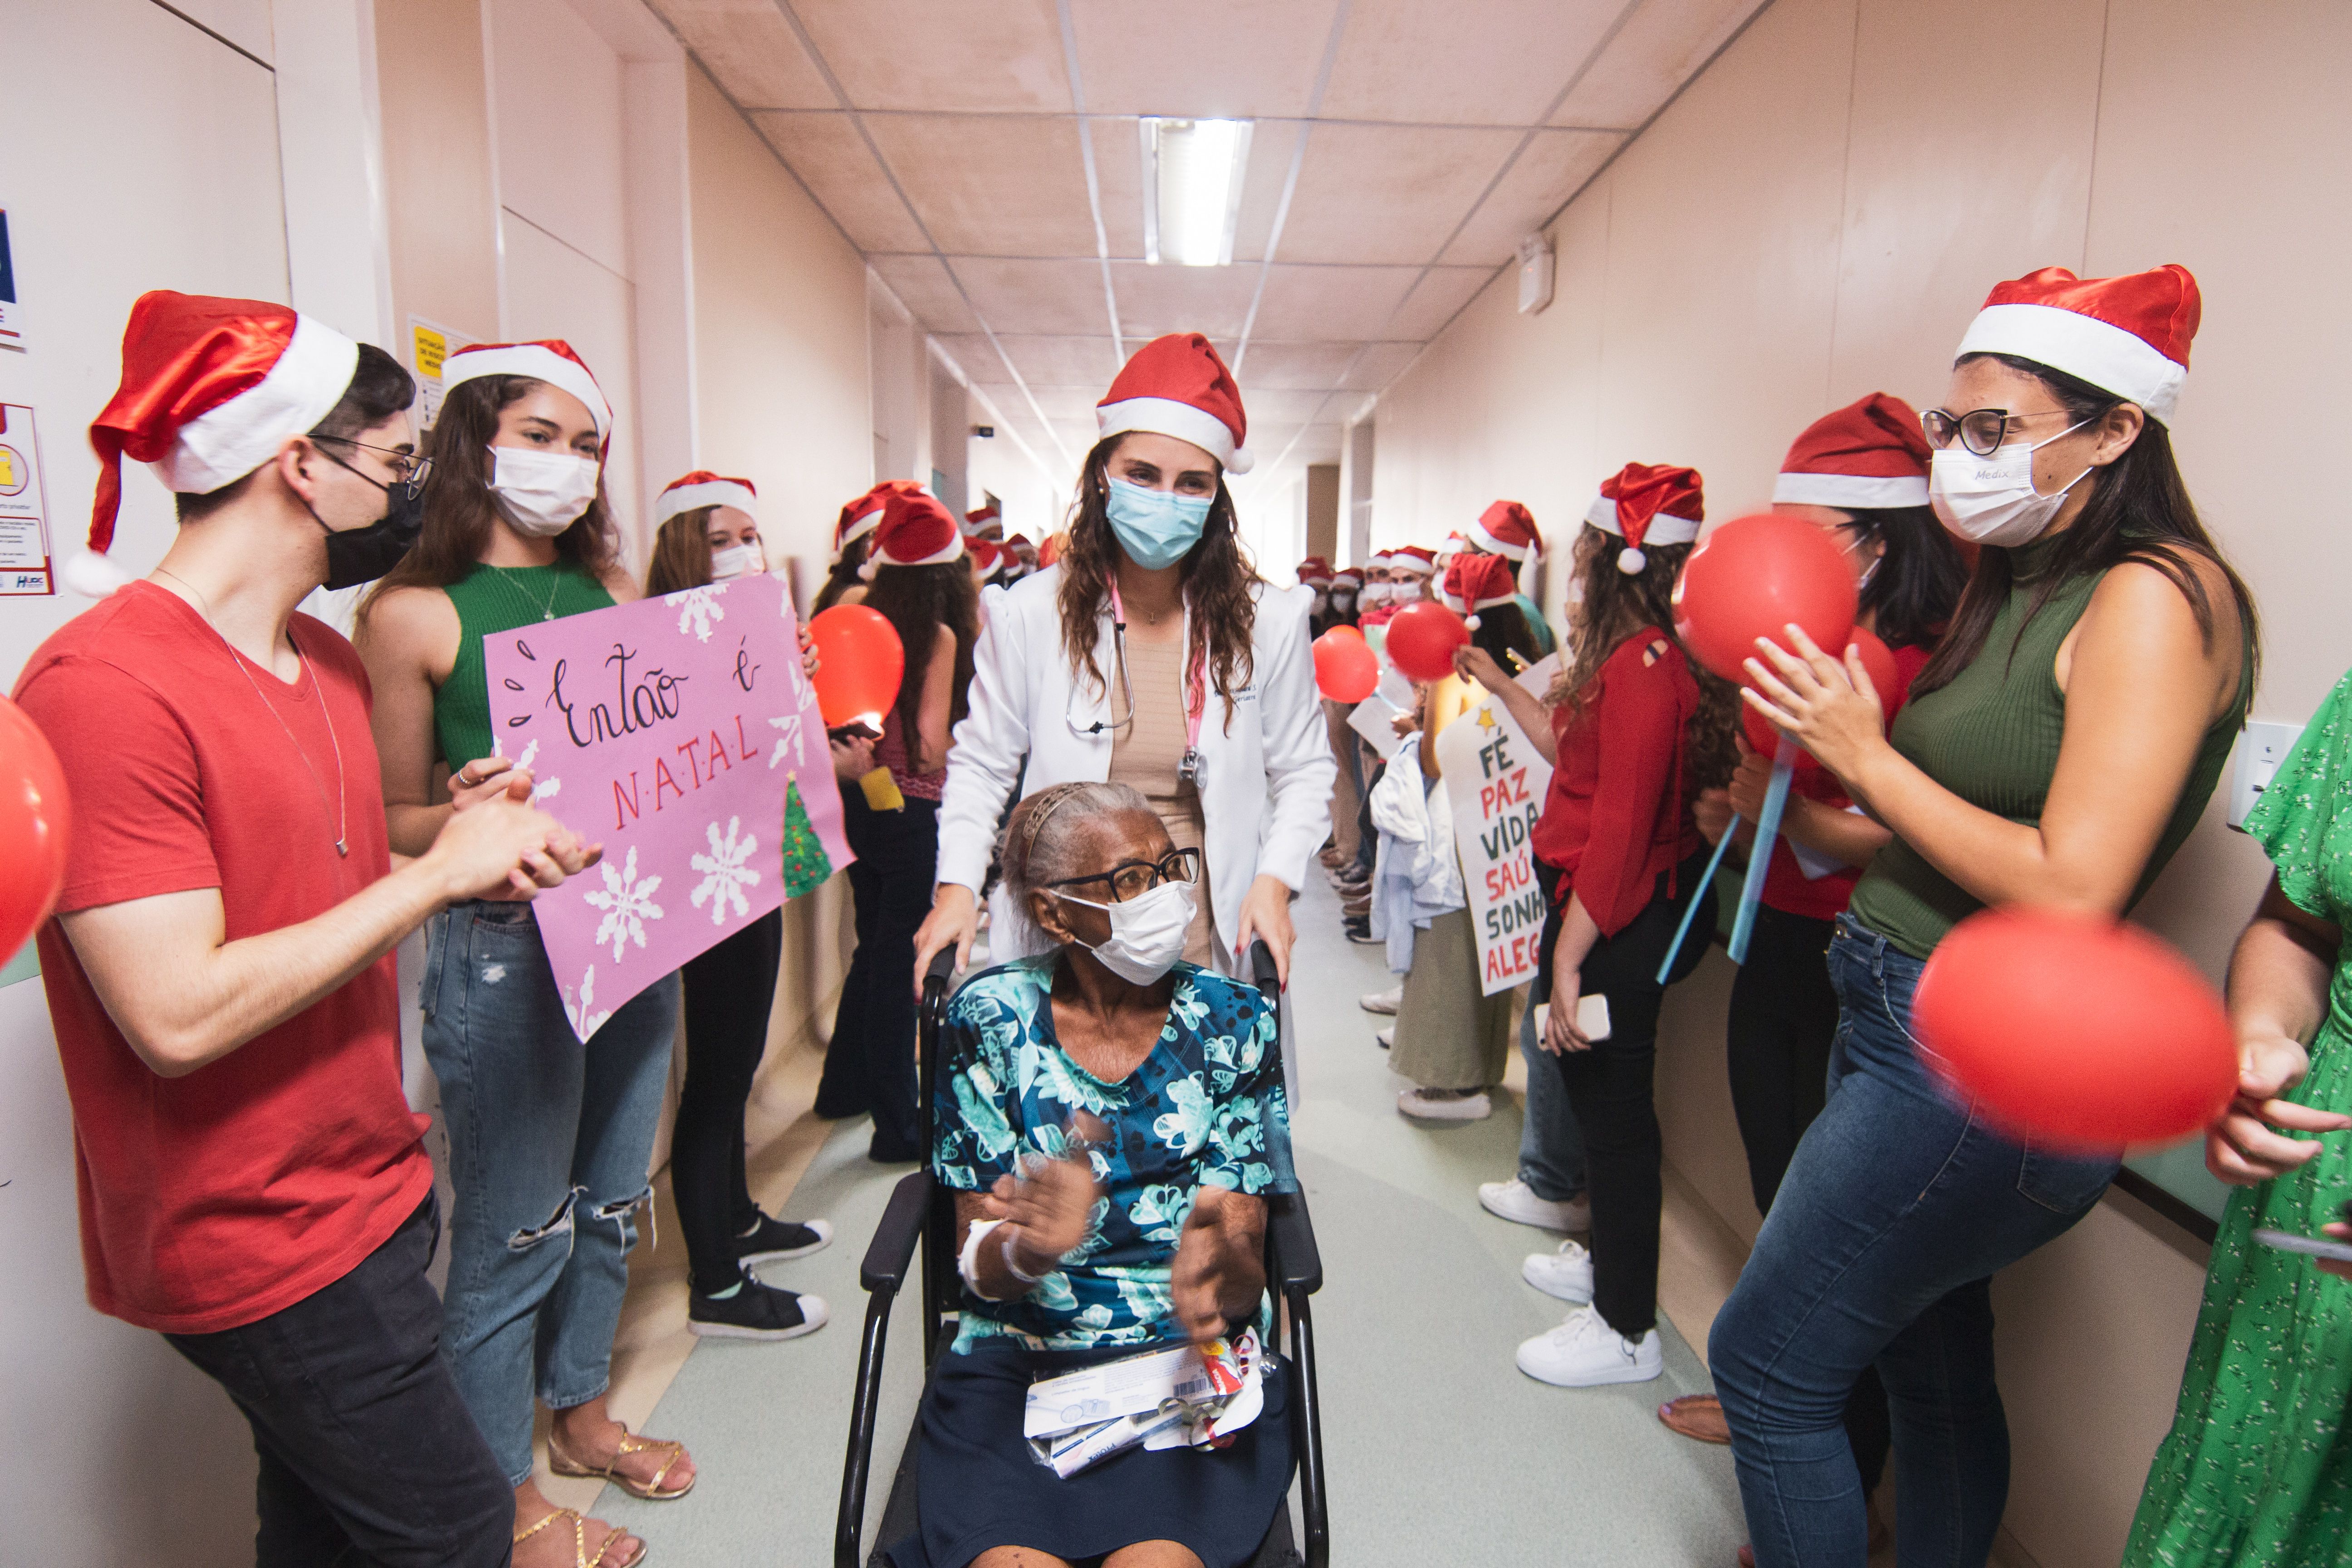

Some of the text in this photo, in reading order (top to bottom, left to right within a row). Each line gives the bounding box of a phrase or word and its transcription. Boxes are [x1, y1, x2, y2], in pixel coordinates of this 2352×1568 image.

[1975, 468, 2009, 480] Medix
[545, 635, 761, 747] Então é
[1479, 726, 1514, 779] FÉ
[1480, 766, 1530, 820] PAZ
[1480, 801, 1540, 861] VIDA
[1485, 848, 1538, 902] SAÚ
